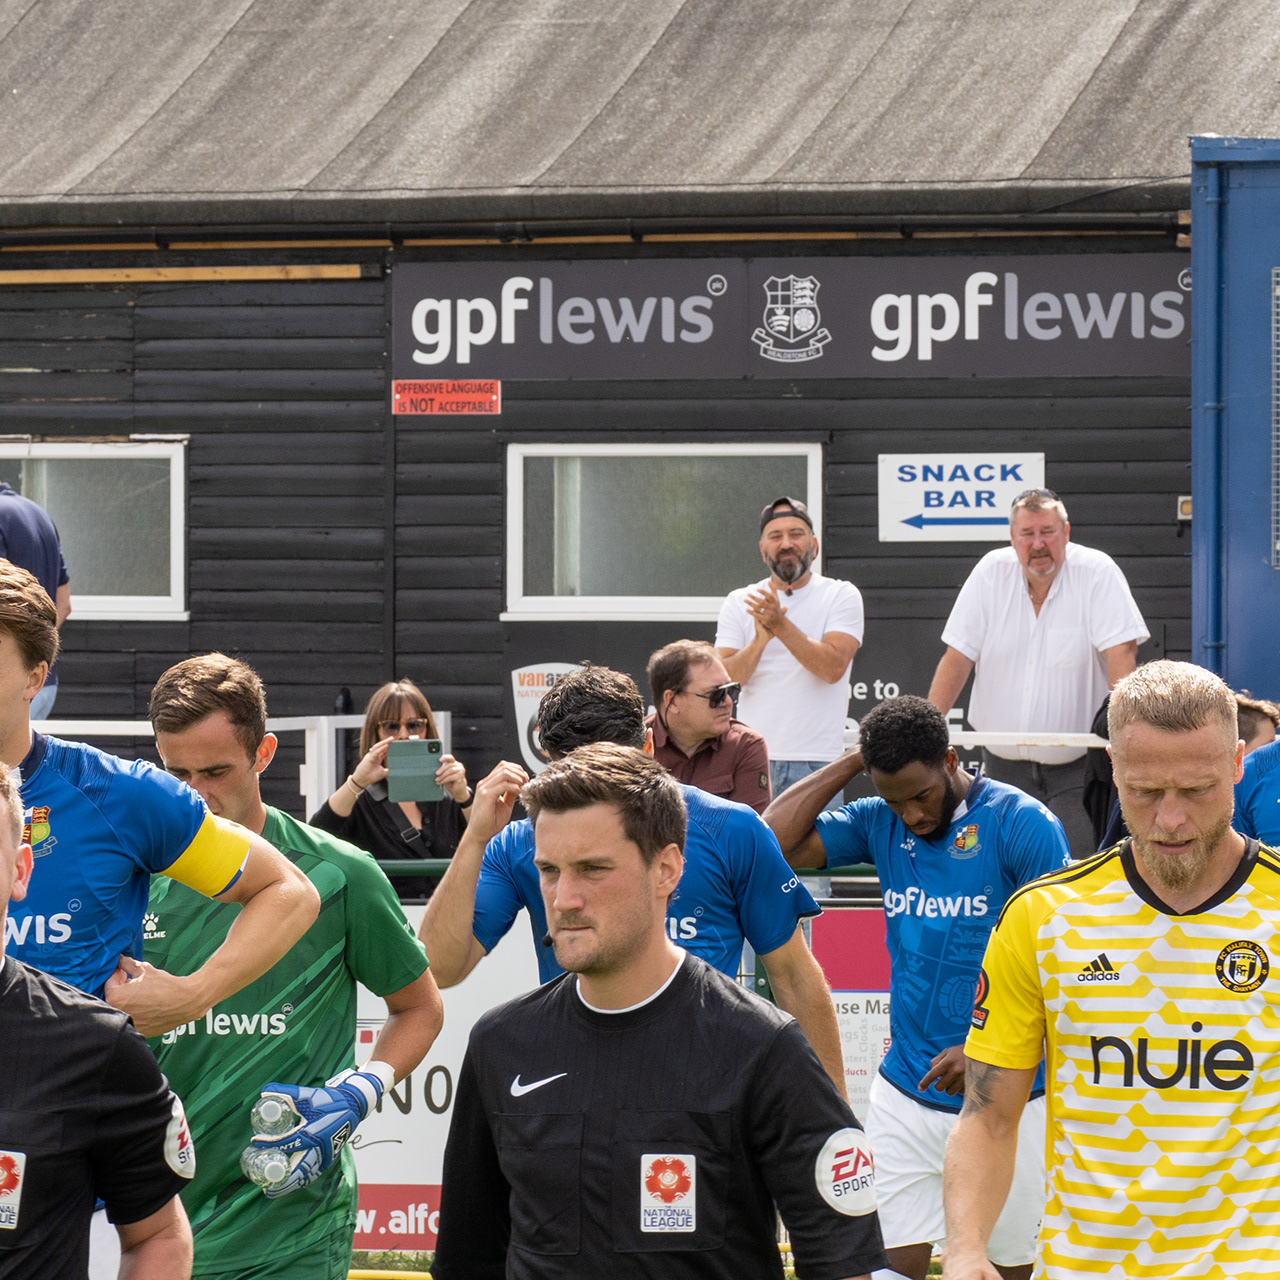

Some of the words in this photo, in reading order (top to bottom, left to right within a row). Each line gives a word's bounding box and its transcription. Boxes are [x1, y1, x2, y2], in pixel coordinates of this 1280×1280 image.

[395, 382, 444, 395] OFFENSIVE
[445, 382, 495, 394] LANGUAGE
[410, 398, 435, 413] NOT
[438, 401, 494, 413] ACCEPTABLE
[897, 463, 1024, 483] SNACK
[923, 490, 997, 508] BAR
[873, 678, 900, 700] to
[1077, 970, 1120, 982] adidas
[858, 1018, 868, 1053] Clocks
[1090, 1020, 1255, 1091] nuie
[643, 1208, 693, 1217] NATIONAL
[643, 1216, 693, 1228] LEAGUE
